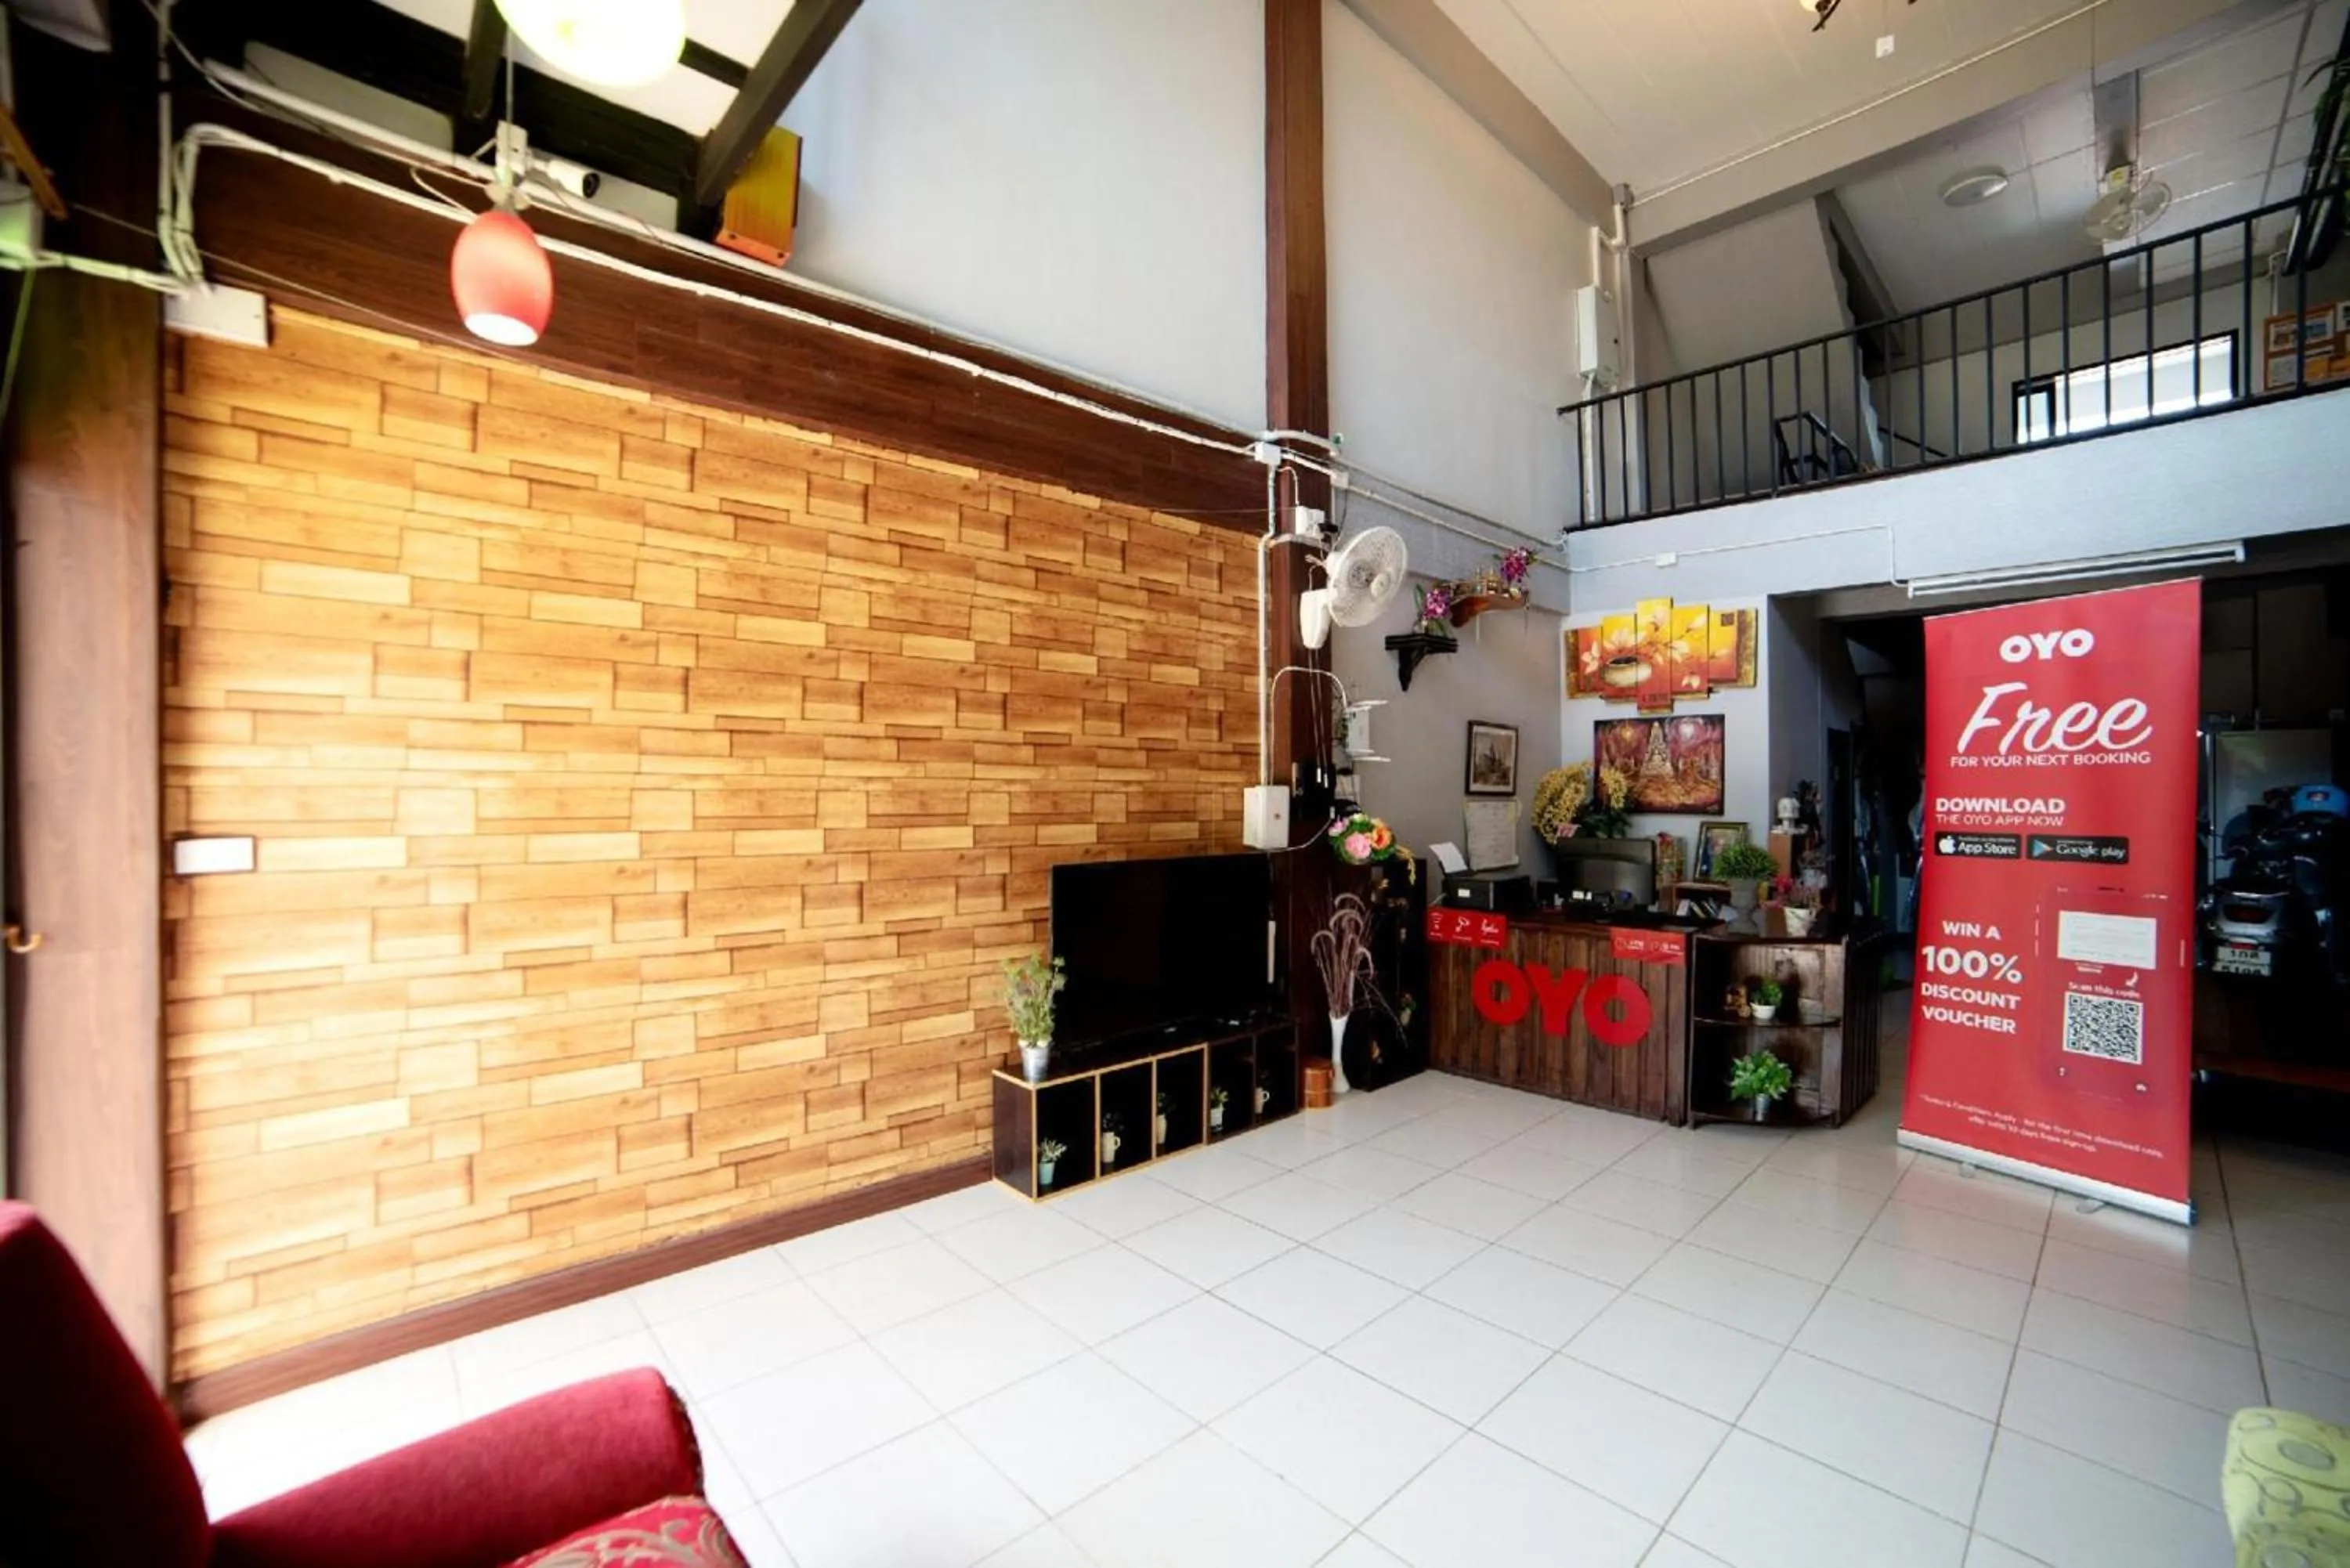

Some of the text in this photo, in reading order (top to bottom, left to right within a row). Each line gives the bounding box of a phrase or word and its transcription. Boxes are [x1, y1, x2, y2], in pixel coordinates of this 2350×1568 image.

[2000, 628, 2094, 663] OYO
[1957, 681, 2153, 754] Free
[1950, 752, 2152, 768] FOR YOUR NEXT BOOKING
[1936, 797, 2066, 814] DOWNLOAD
[1936, 815, 2064, 827] THE OYO APP NOW
[1958, 843, 2016, 854] App Store
[2056, 844, 2126, 858] Google play
[1943, 920, 2001, 940] WIN A
[1922, 945, 2023, 984] 100%
[1472, 959, 1653, 1047] OYO
[1922, 982, 2022, 1010] DISCOUNT
[1922, 1005, 2016, 1035] VOUCHER
